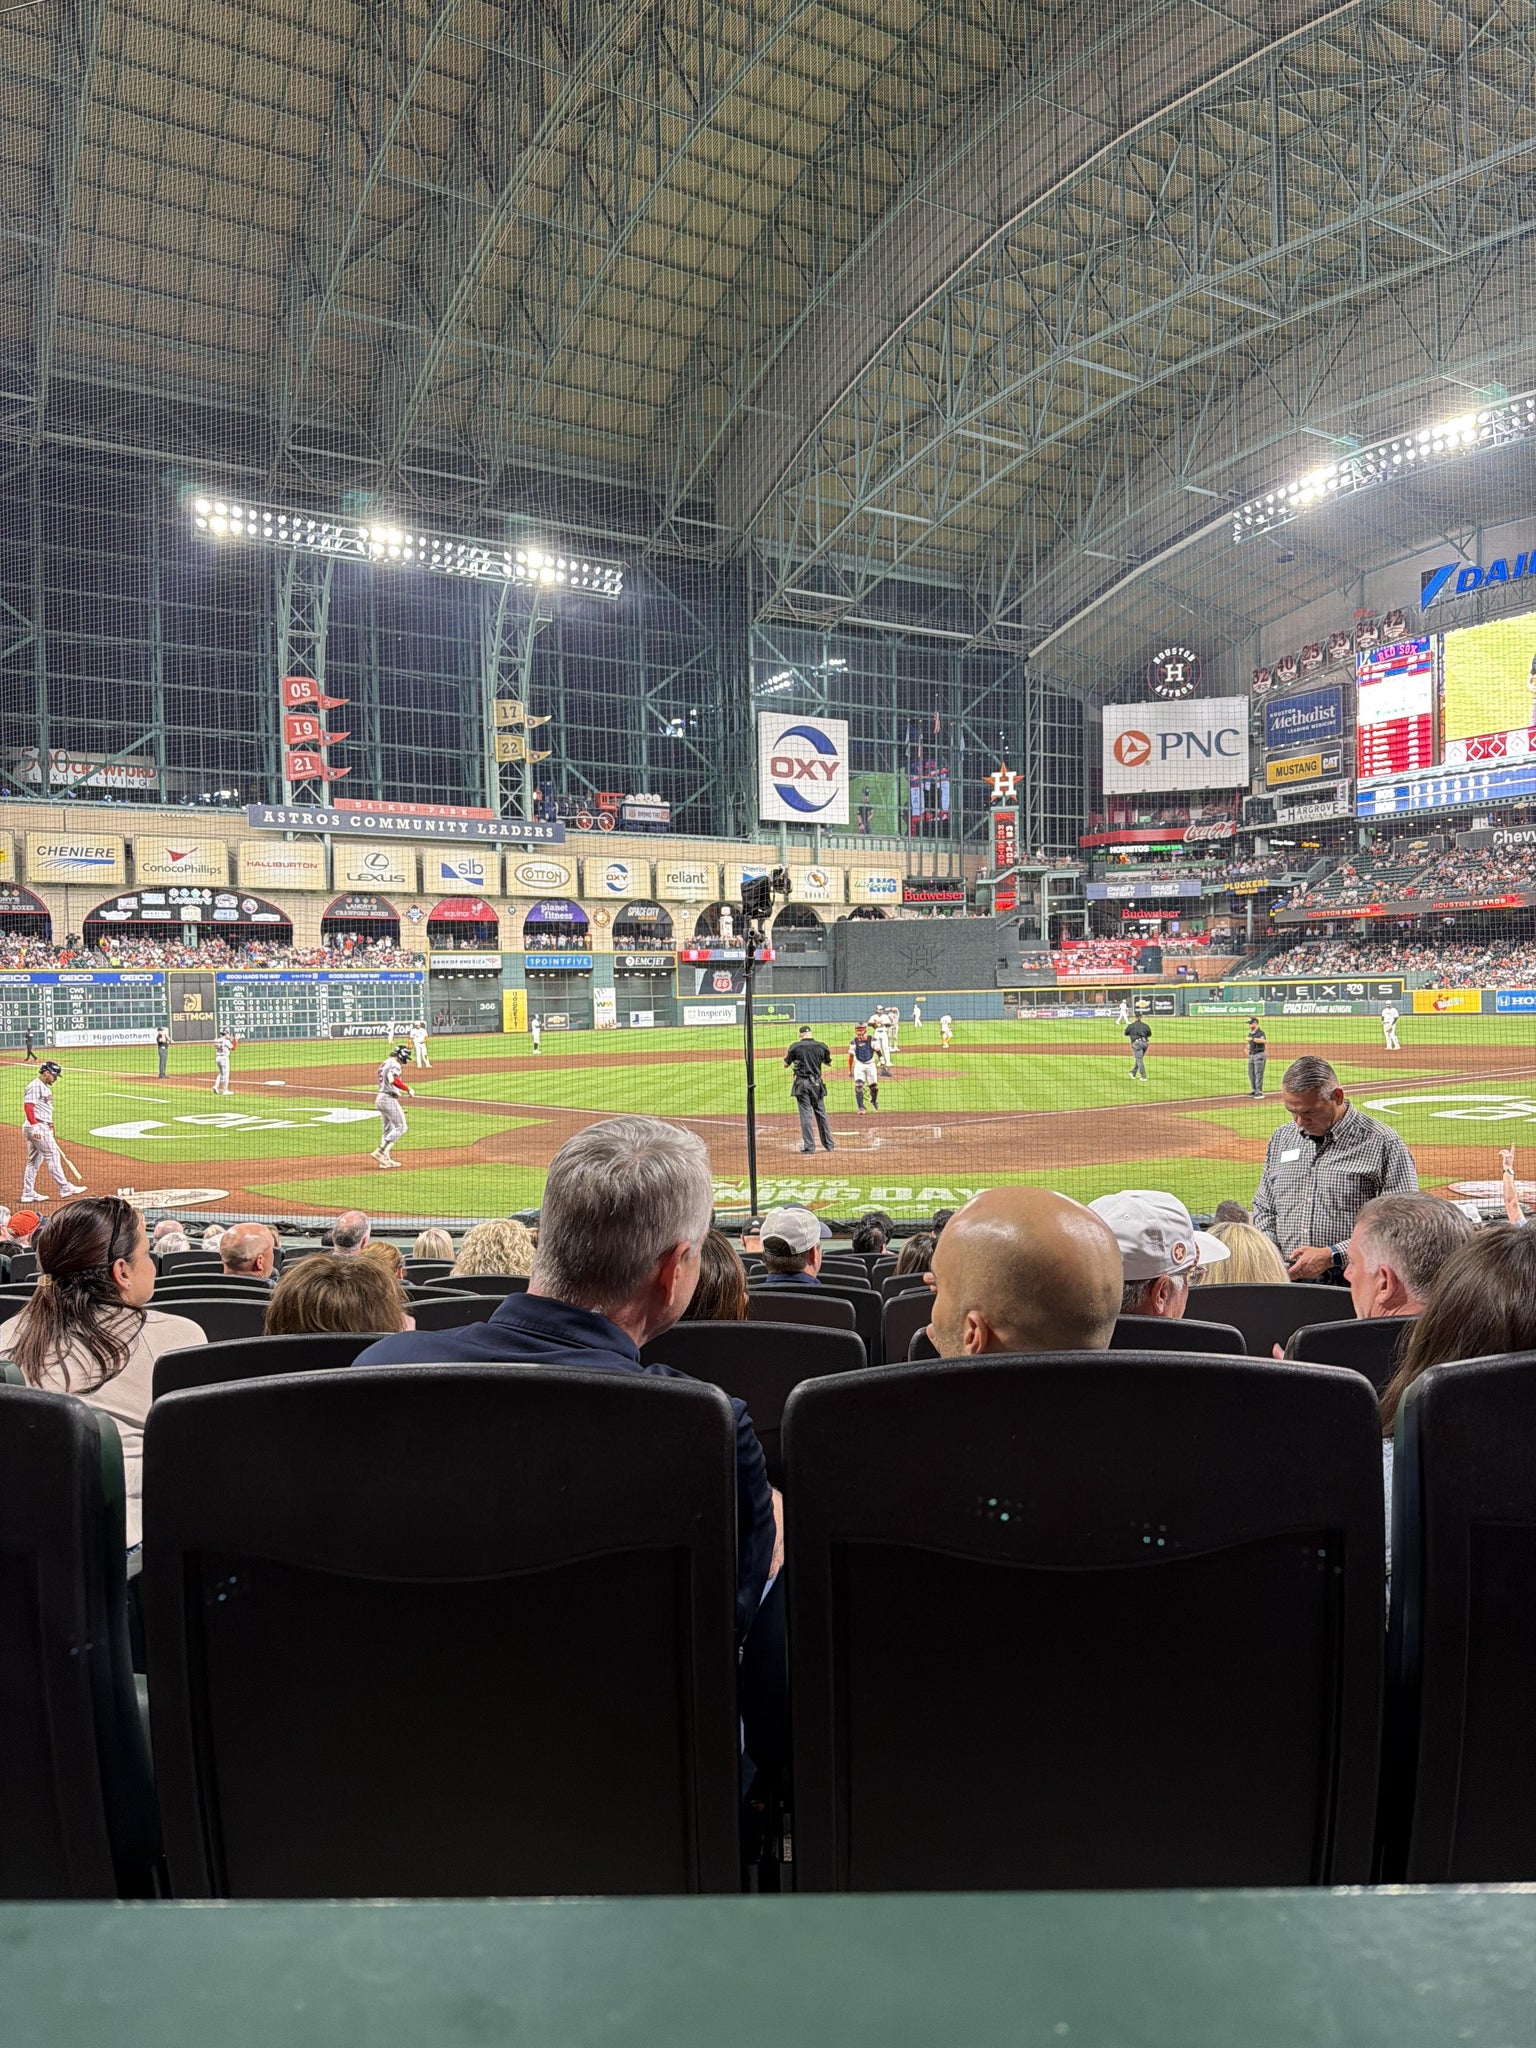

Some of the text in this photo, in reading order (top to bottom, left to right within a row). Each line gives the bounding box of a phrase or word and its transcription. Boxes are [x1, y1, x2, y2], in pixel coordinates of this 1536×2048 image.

[1330, 631, 1347, 649] 33
[1153, 647, 1196, 665] HOUSTON
[1302, 643, 1320, 661] 25
[1377, 644, 1419, 662] RED SOX
[1277, 655, 1294, 672] 40
[1164, 663, 1184, 682] H
[1253, 668, 1269, 685] 32
[290, 683, 311, 698] 05
[1154, 682, 1194, 697] ASTROS
[501, 706, 517, 718] 17
[1270, 708, 1296, 718] HOUSTON
[1270, 705, 1336, 731] Methodist
[293, 722, 312, 736] 19
[1287, 720, 1336, 734] LEADING MEDICINE
[502, 742, 518, 753] 22
[1156, 728, 1240, 760] PNC
[294, 757, 312, 771] 21
[770, 756, 840, 781] OXY
[1276, 761, 1317, 777] MUSTANG
[1323, 756, 1339, 769] CAT
[355, 802, 469, 815] DAIKIN PARK
[1288, 802, 1338, 820] HARGROVE
[263, 811, 554, 838] ASTROS COMMUNITY LEADERS
[37, 845, 116, 858] CHENIERE
[142, 863, 222, 877] ConocoPhillips
[246, 861, 318, 869] HALLIBURTON
[458, 858, 484, 875] slb
[347, 873, 406, 883] LEXUS
[522, 867, 562, 884] COTTON
[666, 871, 705, 884] reliant
[868, 878, 897, 893] LNG
[1224, 879, 1269, 890] PLUCKERS
[903, 889, 965, 902] Budweiser
[541, 904, 568, 913] planet
[1433, 898, 1506, 909] HOUSTON ASTROS
[444, 910, 470, 918] equinor
[544, 911, 574, 920] fitness
[627, 906, 660, 916] SPACE CITY
[1121, 908, 1181, 920] Budweiser
[1307, 907, 1371, 918] HOUSTON ASTROS
[530, 957, 589, 966] 1POINTFIVE
[634, 957, 666, 967] EMCJET
[1079, 966, 1125, 975] Budweiser
[715, 980, 730, 989] 66
[697, 1008, 733, 1019] Insperity
[1283, 1003, 1299, 1014] SPACE
[1299, 1003, 1317, 1013] CITY
[173, 1012, 214, 1021] BETMGM
[344, 1023, 413, 1036] NITTOTIRCOM
[93, 1032, 151, 1042] Higginbotham
[712, 1187, 862, 1201] NING
